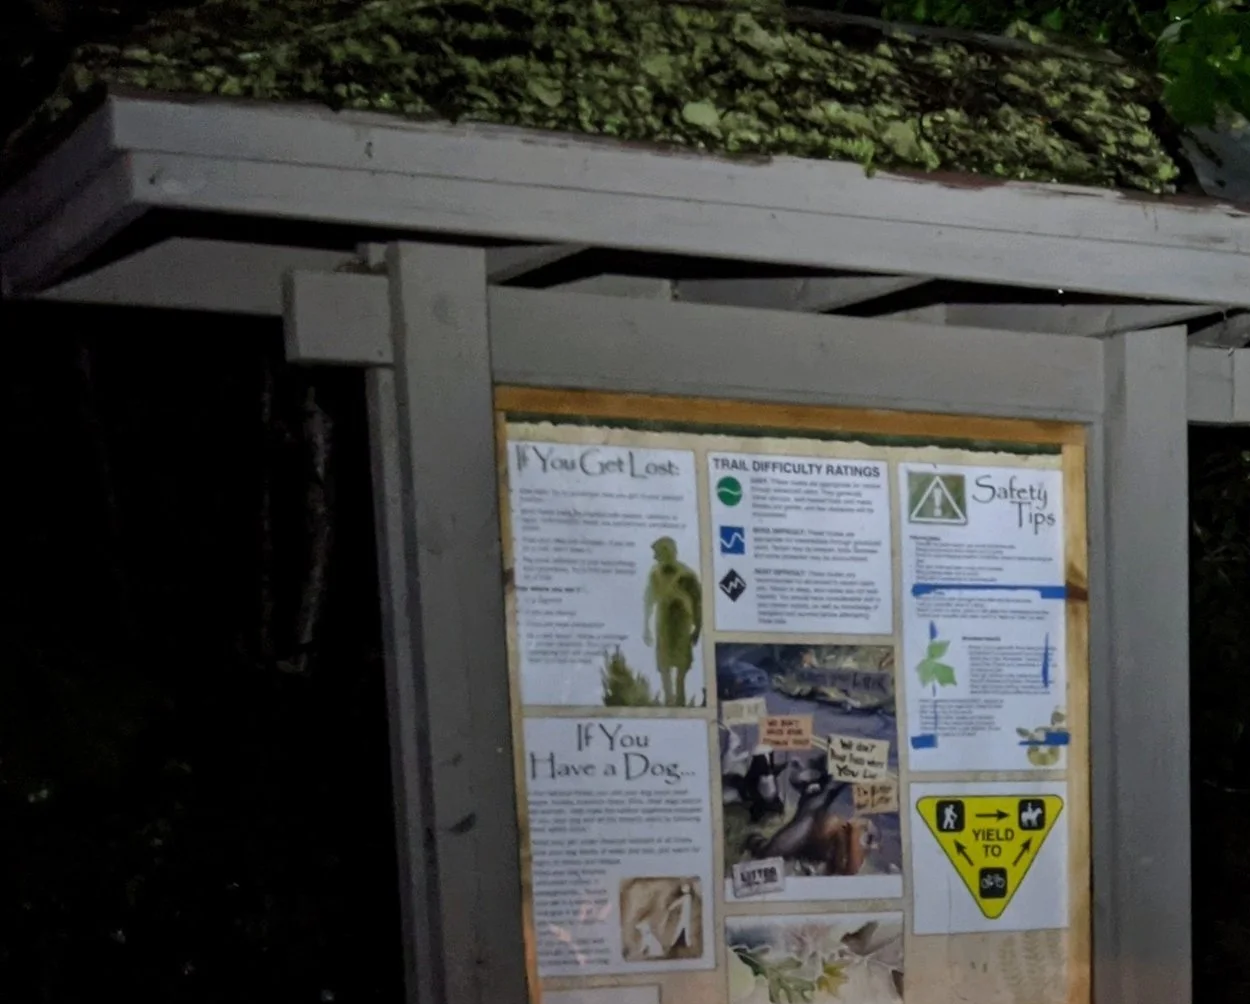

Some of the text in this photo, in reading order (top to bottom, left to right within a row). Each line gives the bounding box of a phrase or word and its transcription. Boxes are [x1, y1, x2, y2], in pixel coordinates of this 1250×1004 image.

[515, 444, 529, 472] If
[532, 445, 577, 473] You
[579, 449, 625, 476] Get
[712, 457, 881, 478] TRAIL DIFFICULTY RATINGS
[971, 474, 1048, 510] Safety
[1010, 500, 1056, 535] Tips
[576, 722, 649, 752] If You
[529, 752, 597, 780] Have
[602, 764, 617, 777] a
[972, 828, 1015, 842] YIELD
[982, 844, 1003, 857] TO
